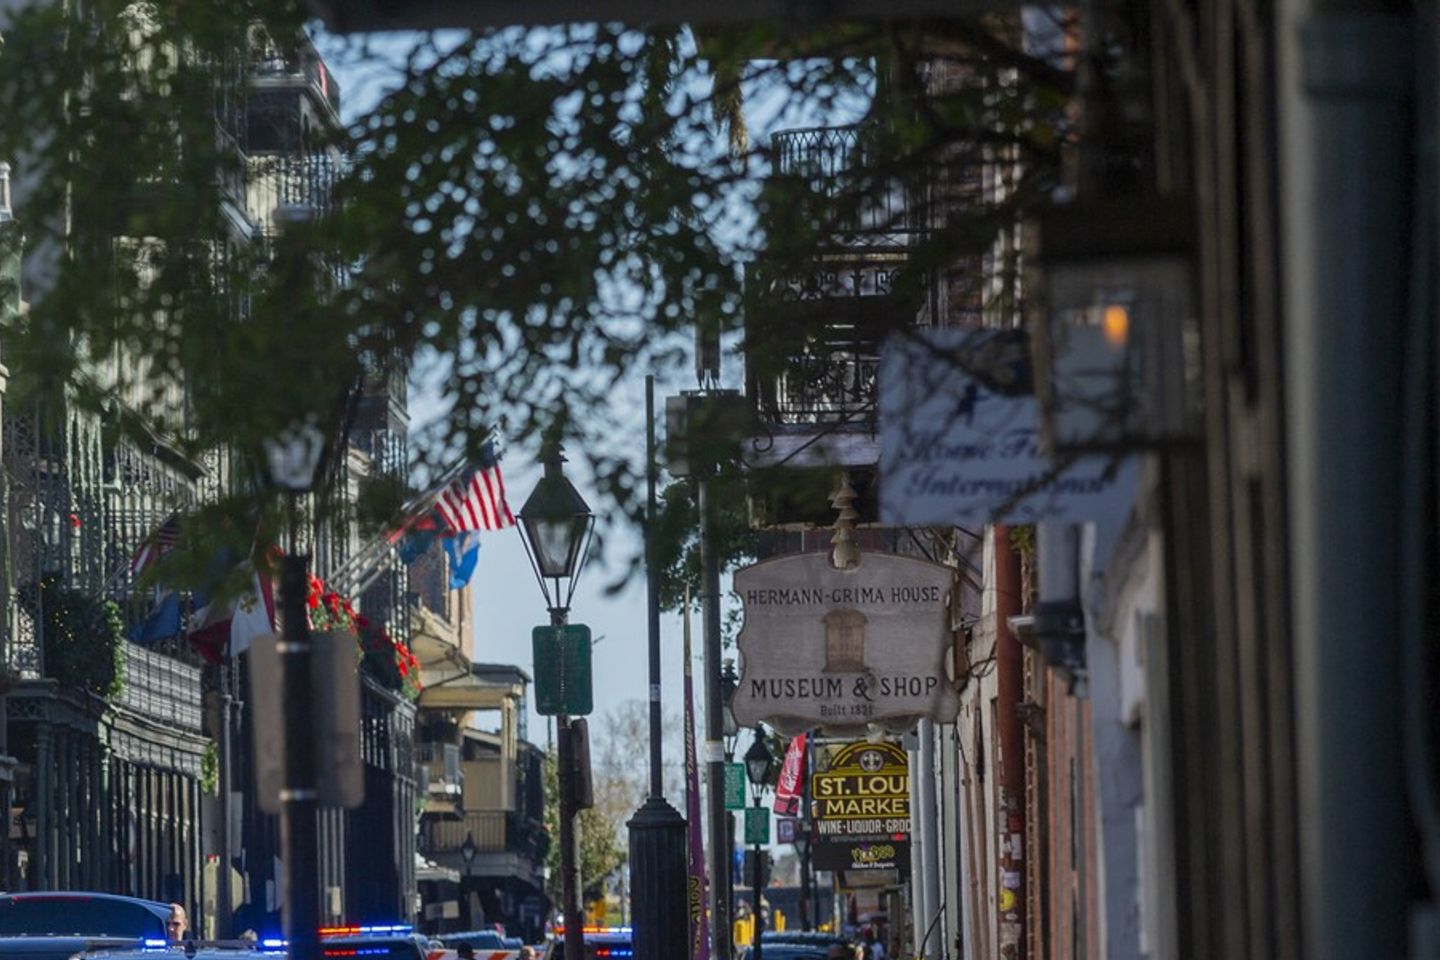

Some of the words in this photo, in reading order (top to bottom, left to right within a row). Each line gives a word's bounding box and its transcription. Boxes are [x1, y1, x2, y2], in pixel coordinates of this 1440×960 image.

[747, 587, 885, 604] HERMANN-GRIMA
[891, 586, 939, 602] HOUSE
[751, 677, 843, 699] MUSEUM
[852, 677, 872, 701] &
[880, 676, 938, 697] SHOP
[820, 704, 846, 716] Built
[820, 777, 851, 795] ST.
[858, 776, 910, 795] LOUI
[826, 798, 911, 815] MARKE
